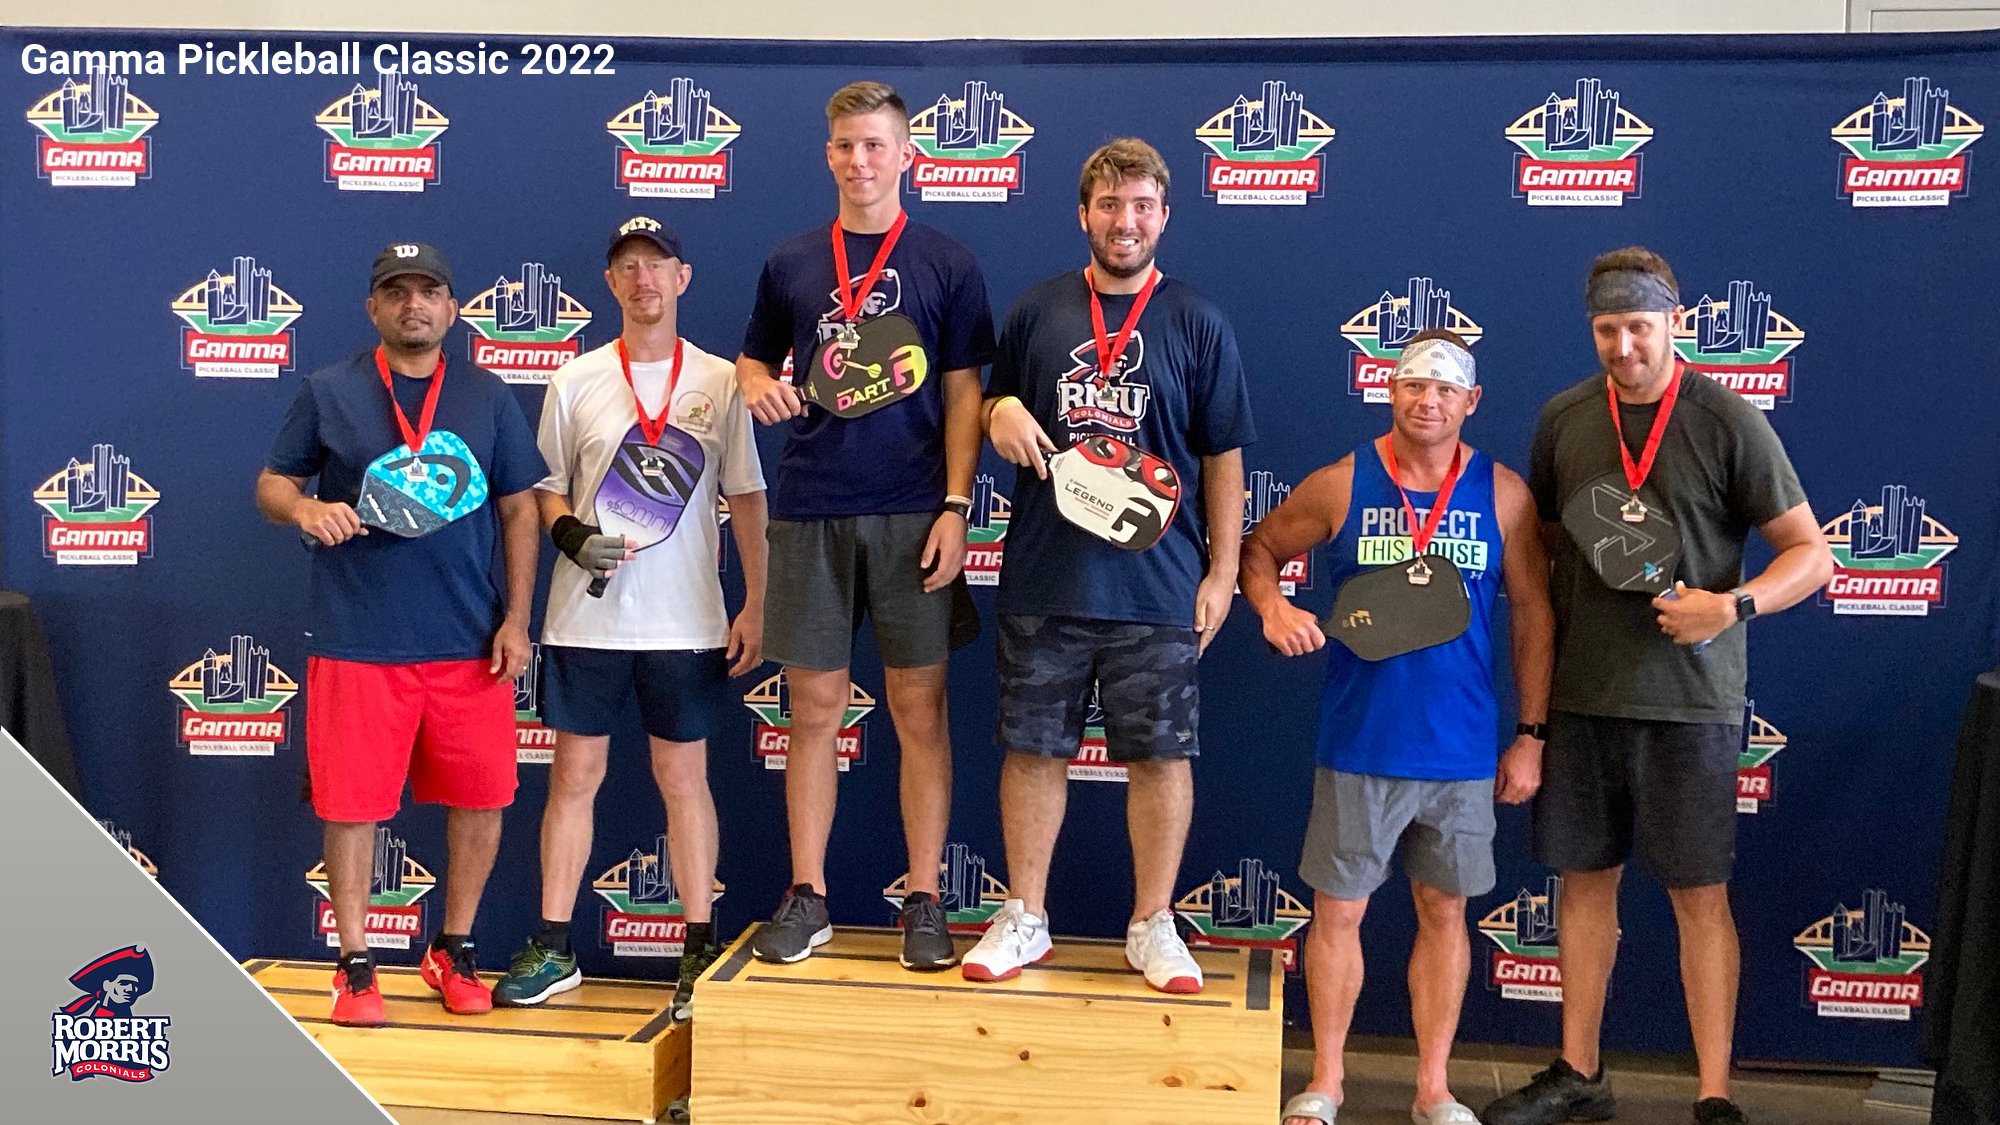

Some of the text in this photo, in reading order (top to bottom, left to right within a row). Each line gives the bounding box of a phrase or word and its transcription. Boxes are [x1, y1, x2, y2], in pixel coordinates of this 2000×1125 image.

[46, 148, 143, 167] GAMMA
[333, 153, 432, 172] GAMMA
[624, 160, 724, 180] GAMMA
[916, 163, 1016, 182] GAMMA
[1212, 166, 1316, 185] GAMMA
[1523, 166, 1633, 186] GAMMA
[1848, 167, 1960, 187] GAMMA
[1856, 195, 1907, 203] PICKLEBALL
[619, 216, 662, 236] PITT
[190, 339, 287, 359] GAMMA
[477, 346, 575, 366] GAMMA
[837, 377, 891, 411] DART
[1074, 410, 1132, 428] COLONIALS
[1064, 483, 1115, 513] LEGEND
[52, 527, 144, 546] GAMMA
[1360, 539, 1405, 562] THIS
[1829, 574, 1938, 595] GAMMA
[186, 718, 282, 738] GAMMA
[193, 744, 271, 752] PICKLEBALL CLASSIC
[609, 919, 686, 939] GAMM
[1812, 976, 1919, 1000] GAMMA
